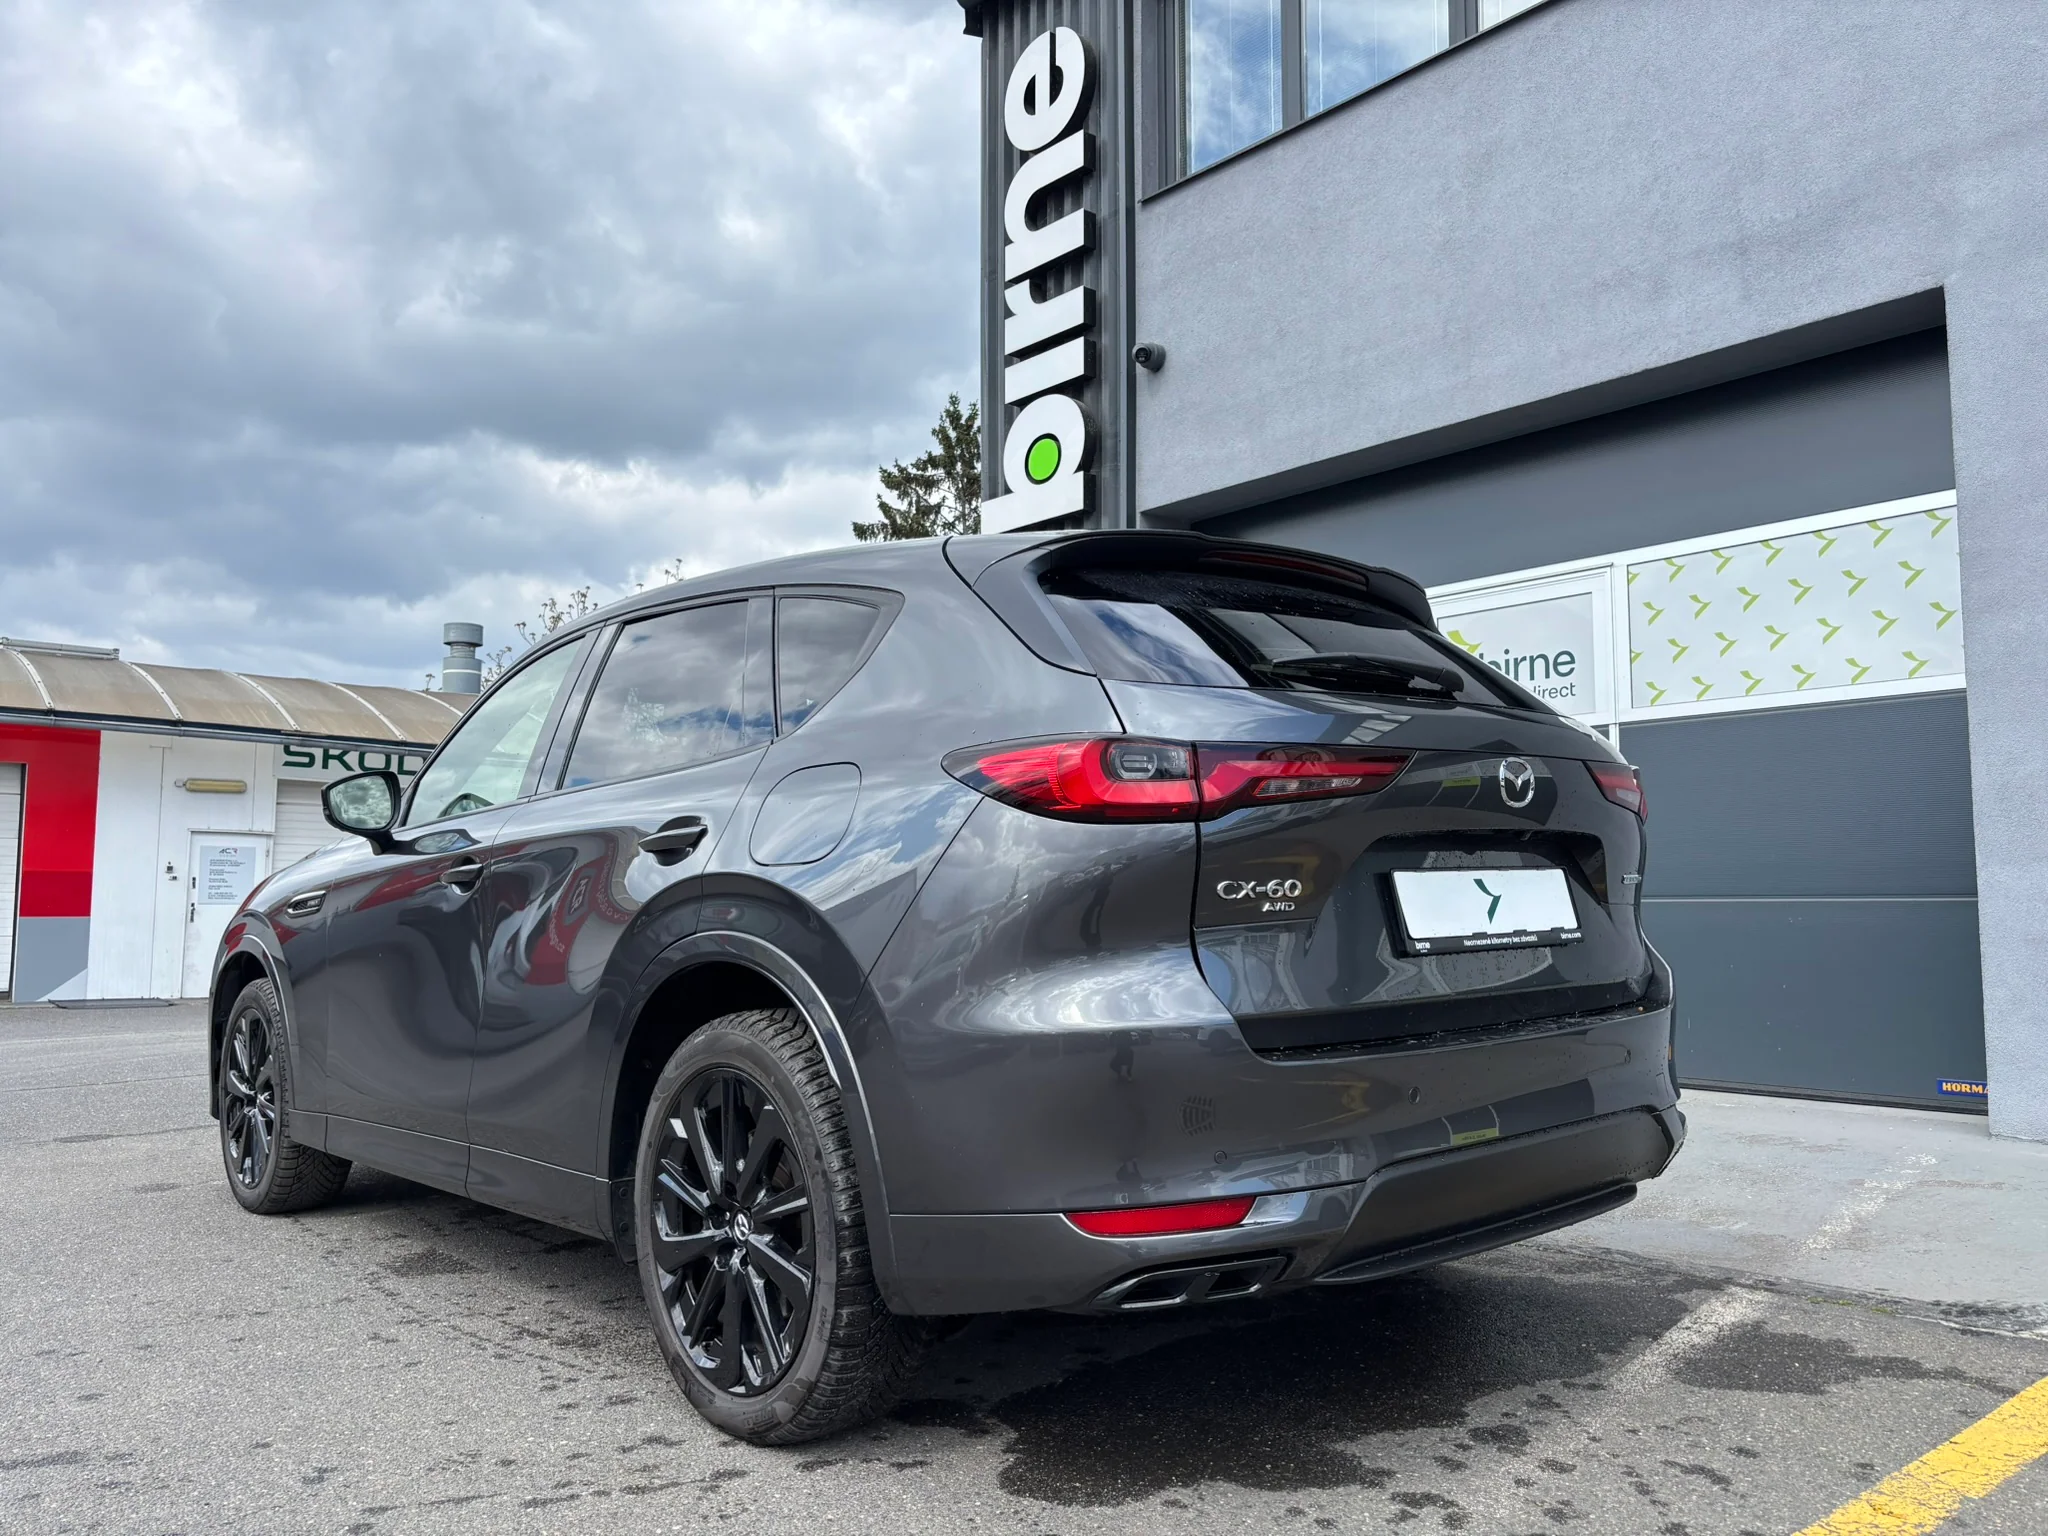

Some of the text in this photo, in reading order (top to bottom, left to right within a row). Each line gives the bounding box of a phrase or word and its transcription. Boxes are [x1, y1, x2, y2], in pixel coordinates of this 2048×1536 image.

[981, 26, 1096, 533] birne
[1533, 682, 1576, 699] irect
[1217, 879, 1302, 899] CX-60
[1262, 902, 1295, 912] AWD
